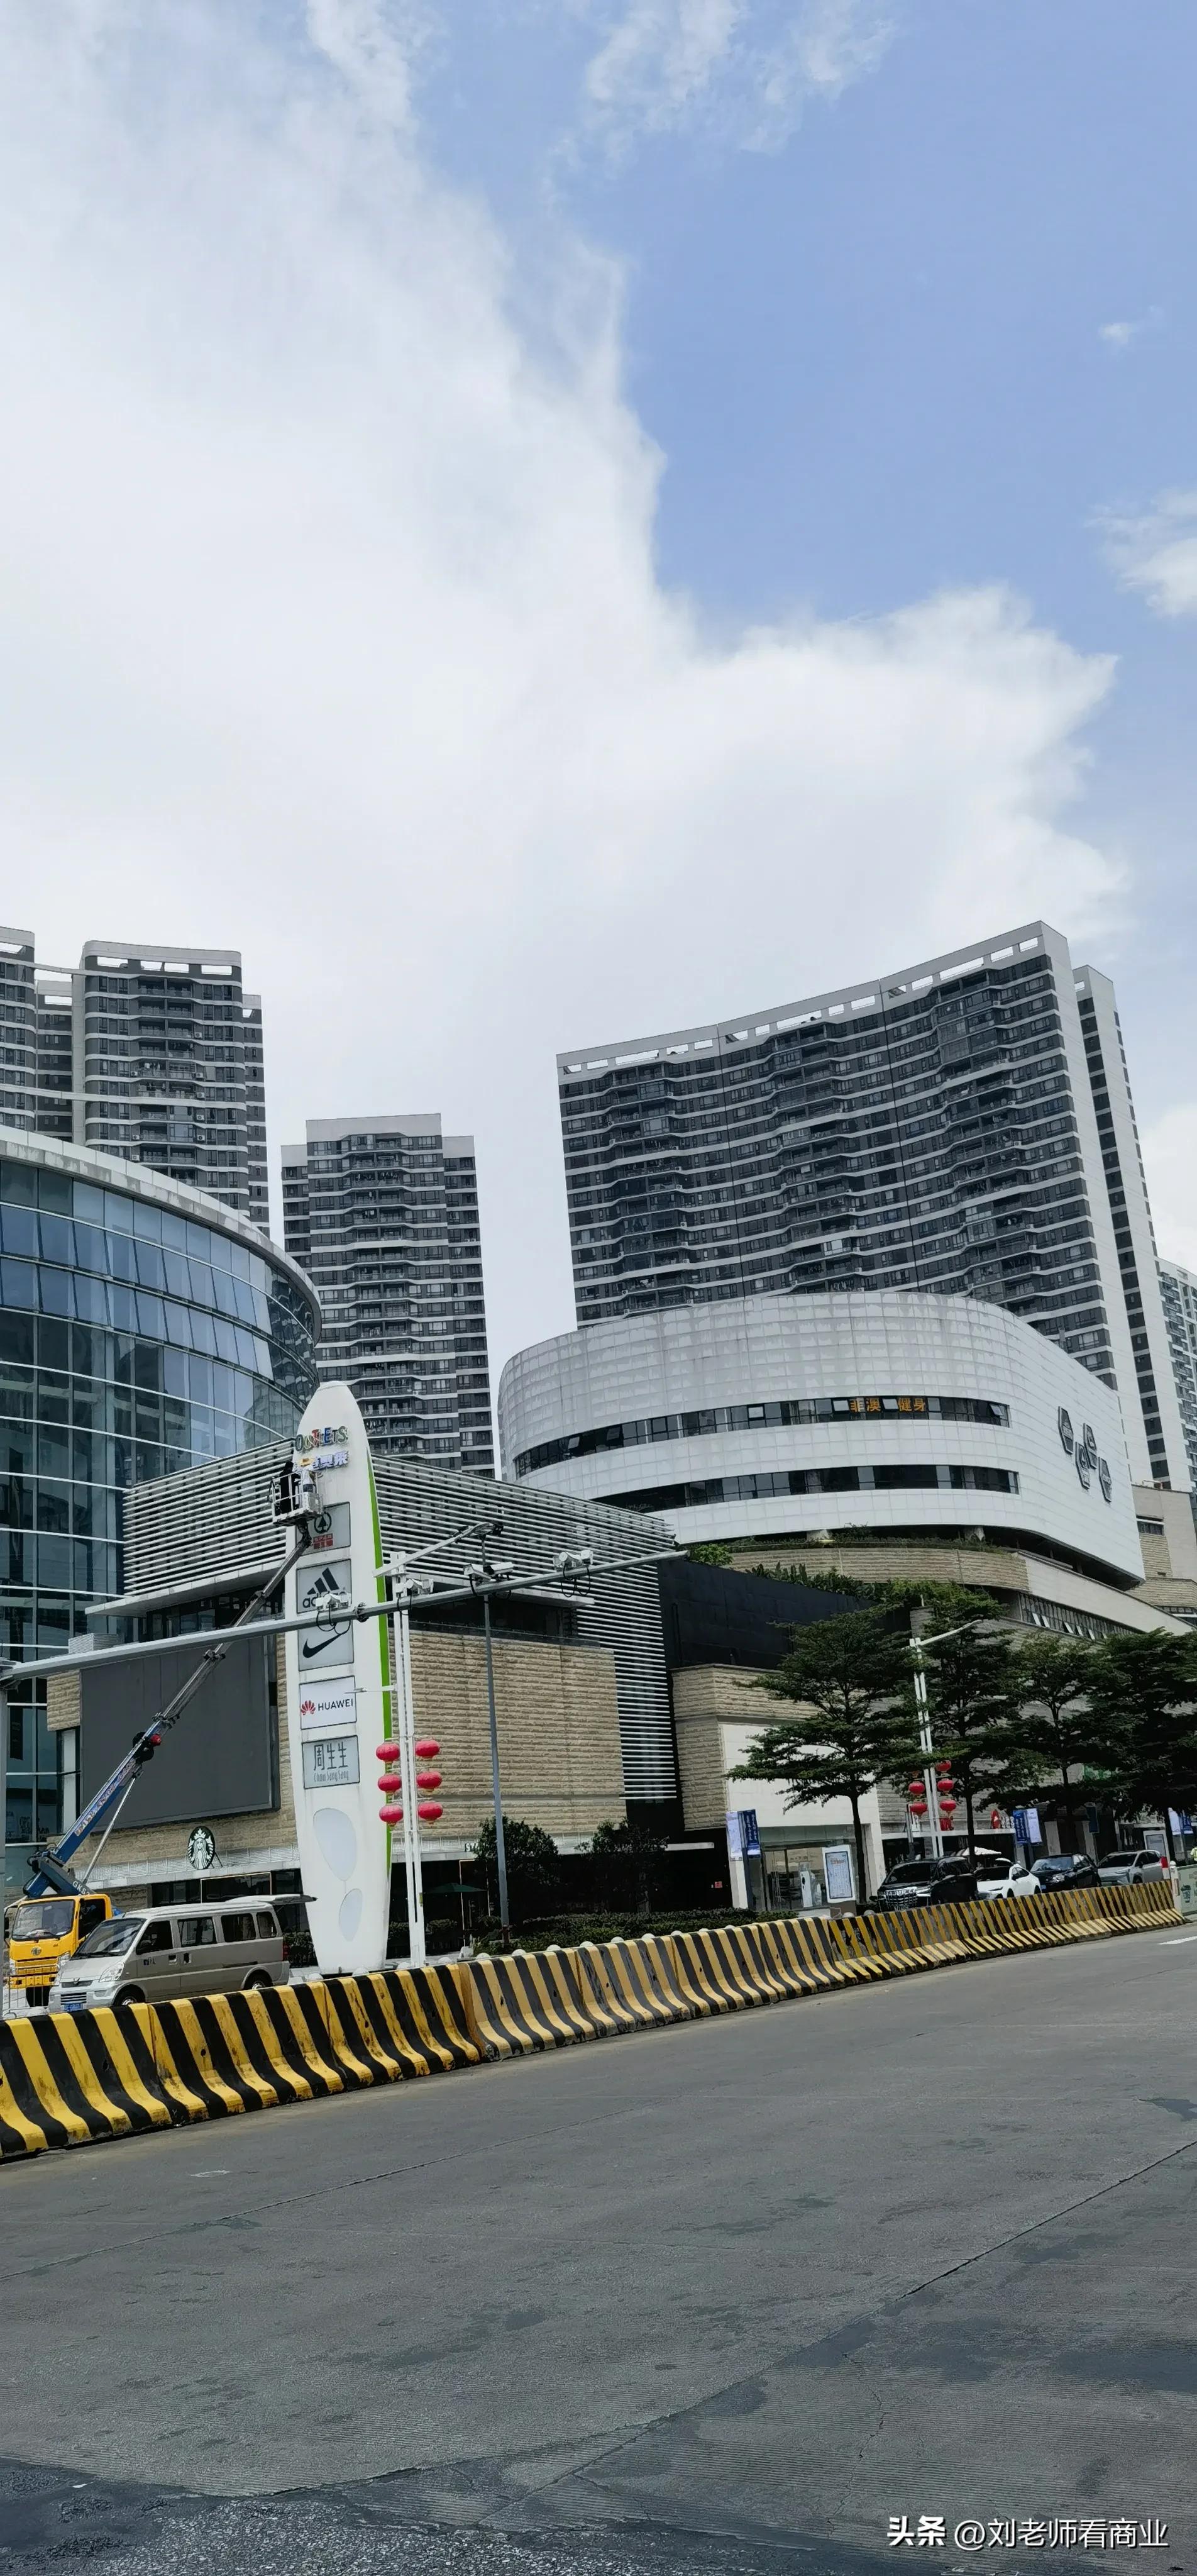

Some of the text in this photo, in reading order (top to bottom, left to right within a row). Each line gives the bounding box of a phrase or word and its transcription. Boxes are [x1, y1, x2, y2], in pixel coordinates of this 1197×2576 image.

[295, 1426, 348, 1452] OUTLETS
[317, 1698, 353, 1711] HUAWEI
[314, 1741, 349, 1771] 周生生
